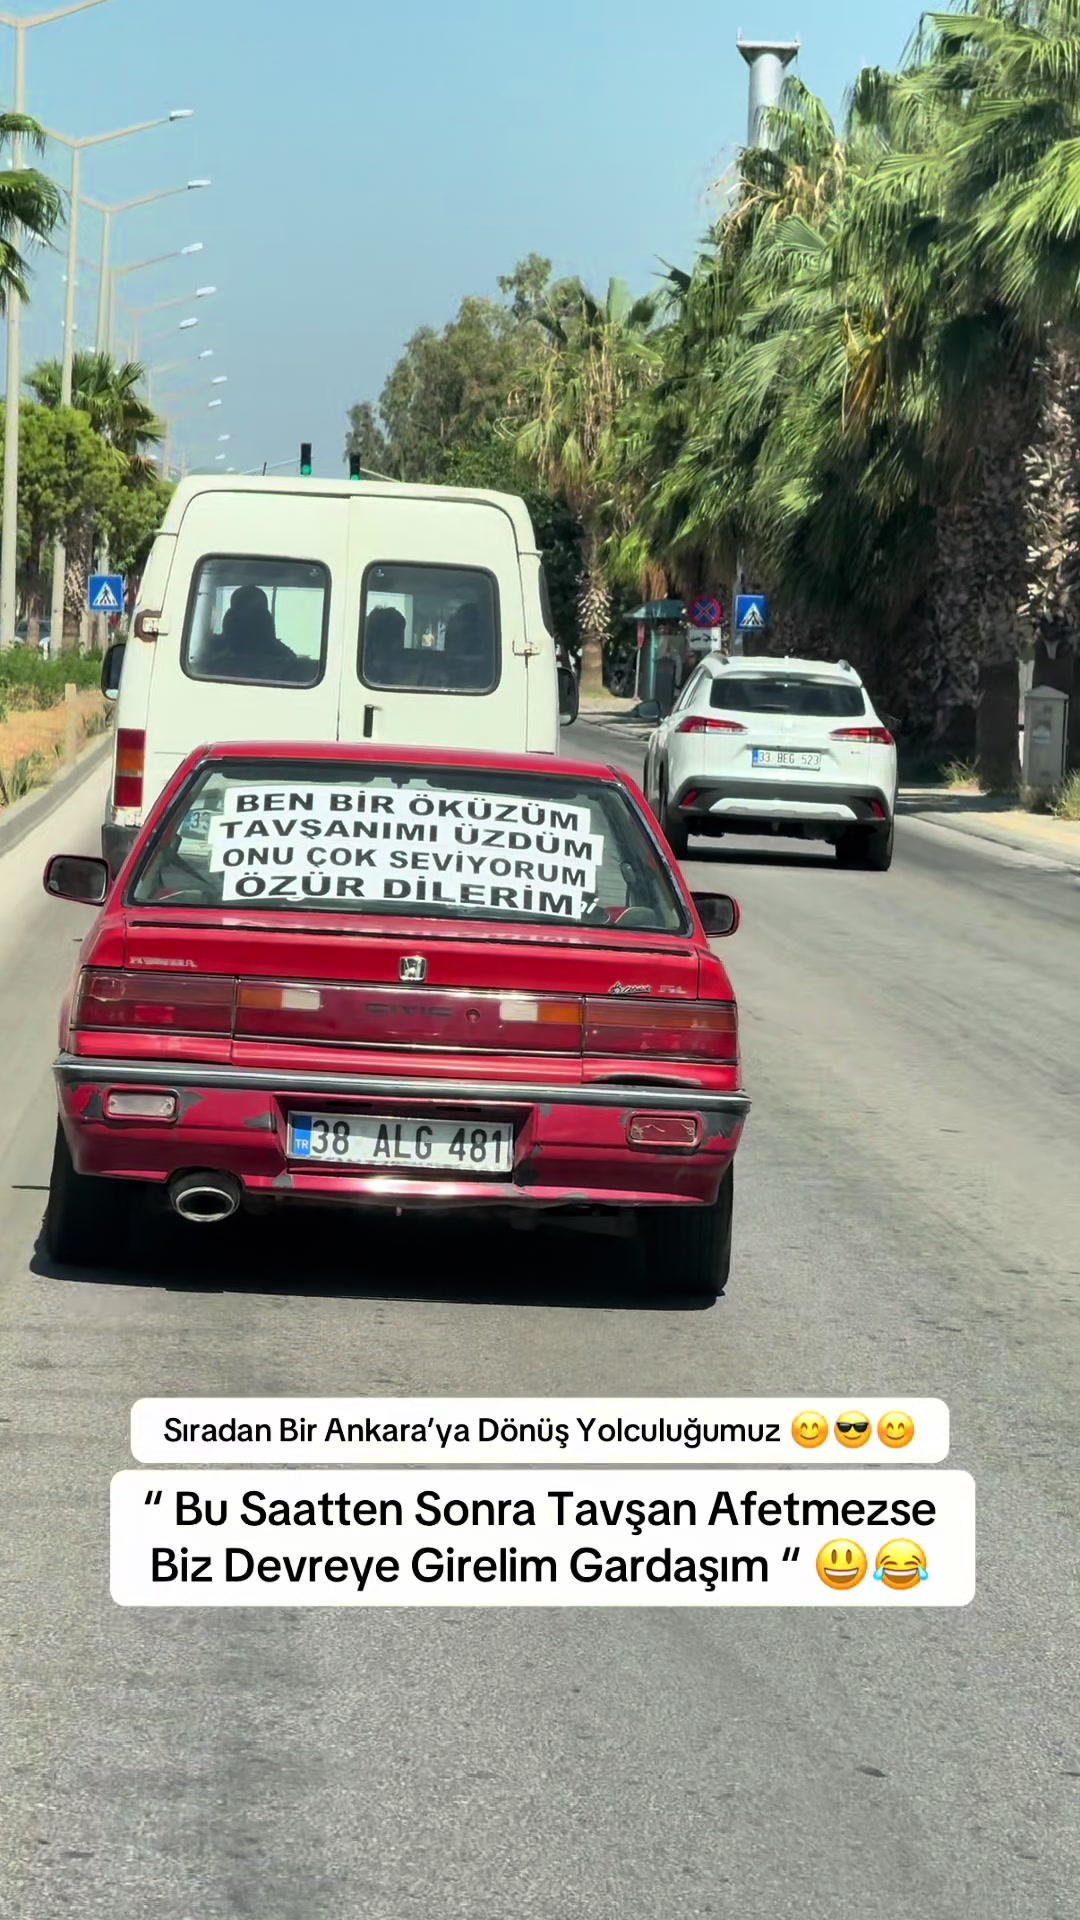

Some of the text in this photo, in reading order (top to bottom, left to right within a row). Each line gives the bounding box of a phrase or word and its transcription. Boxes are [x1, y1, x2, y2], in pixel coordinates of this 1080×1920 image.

[759, 752, 770, 763] 33
[236, 790, 579, 832] BEN BİR ÖKÜZÜM
[219, 818, 593, 861] TAVŞANIMI ÜZDÜM
[222, 846, 586, 888] ONU ÇOK SEVİYORUM
[235, 871, 365, 898] ÖZÜR
[383, 875, 573, 916] DİLERİM
[295, 1138, 309, 1150] TR
[312, 1119, 503, 1164] 38 ALG 481
